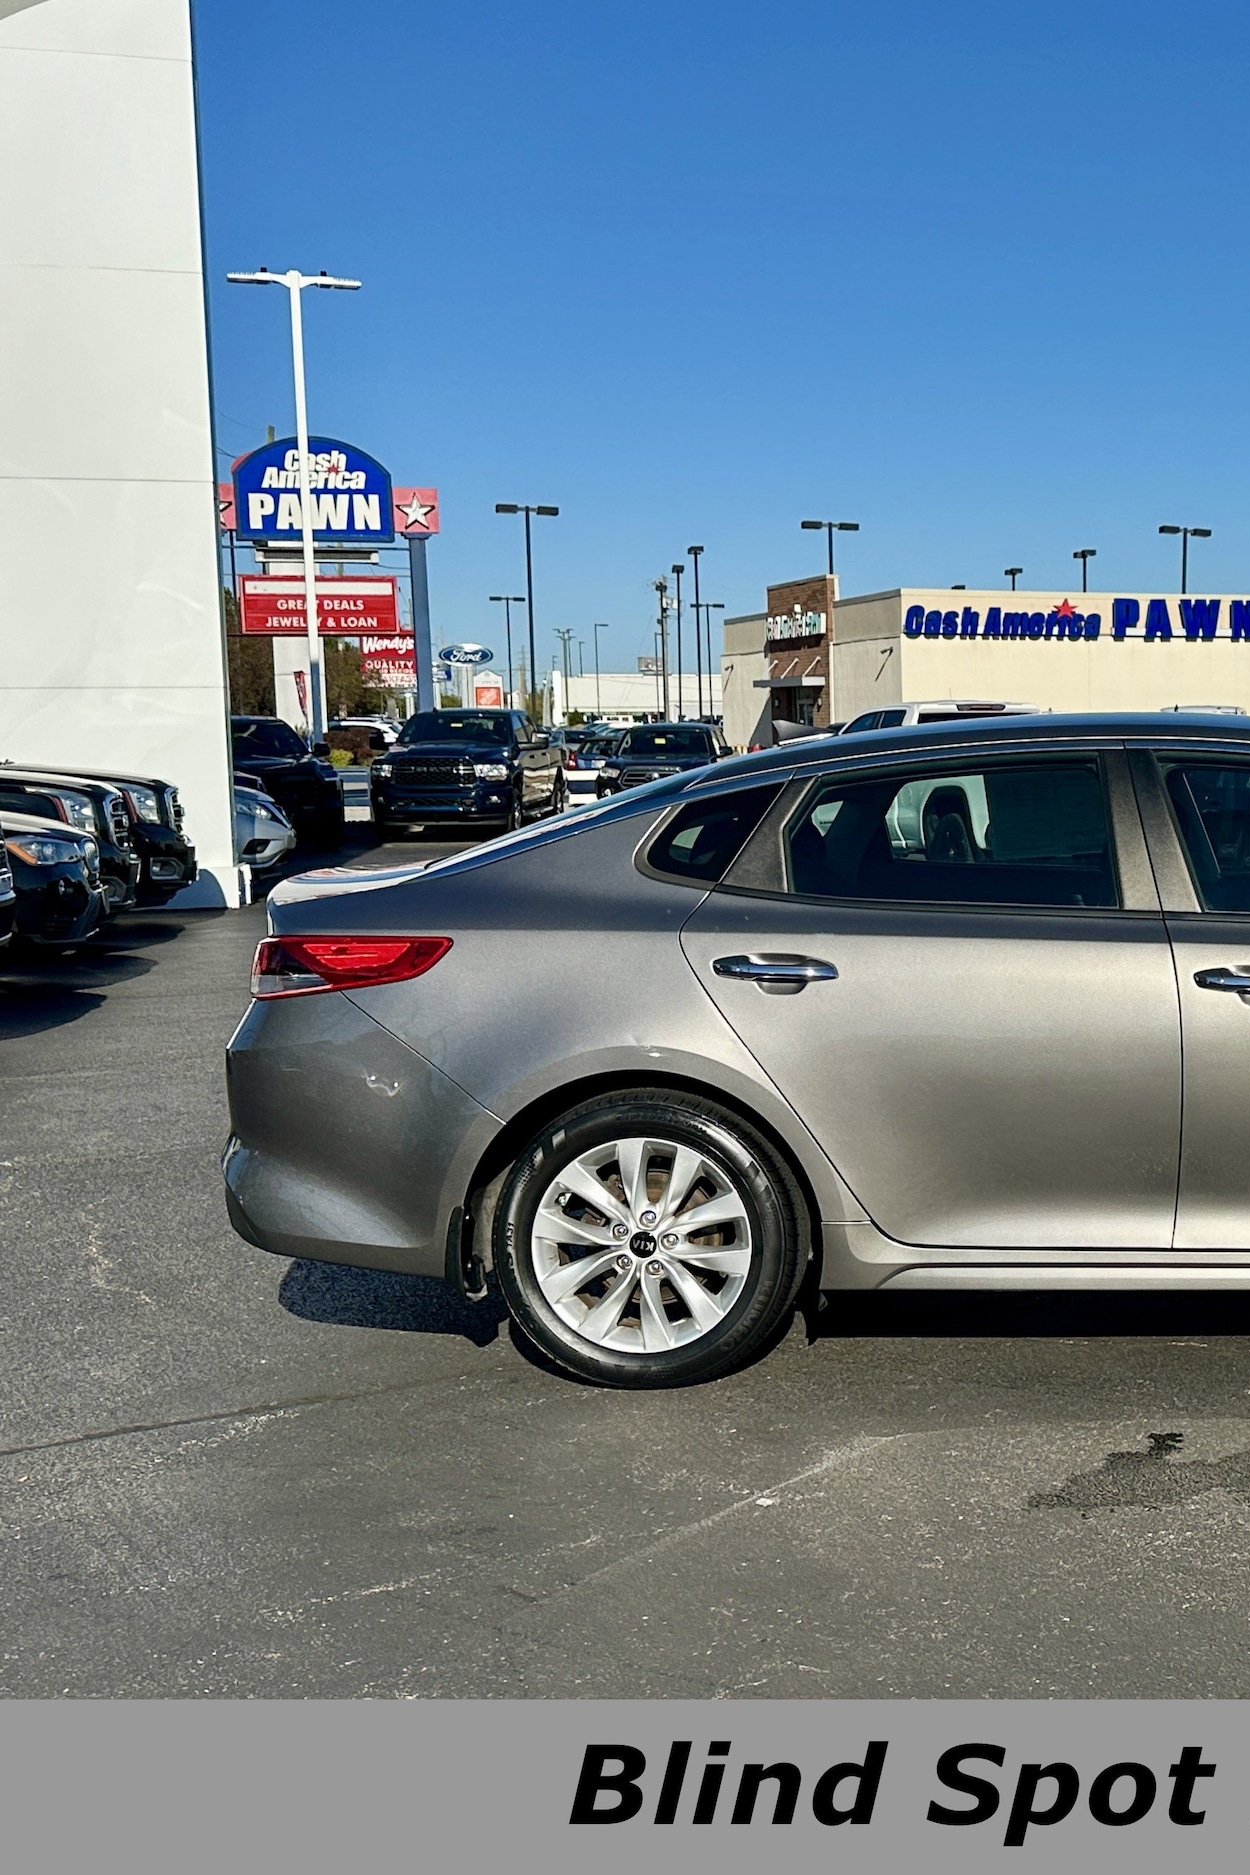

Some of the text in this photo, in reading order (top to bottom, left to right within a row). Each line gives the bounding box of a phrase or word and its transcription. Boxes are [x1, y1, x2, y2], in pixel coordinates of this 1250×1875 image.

[284, 449, 347, 471] Cash
[261, 467, 366, 489] America
[248, 493, 381, 530] PAWN
[277, 599, 364, 611] GRE DEALS
[266, 616, 378, 627] JEWELY & LOAN
[905, 605, 980, 639] Cash
[982, 607, 1101, 640] America
[362, 636, 415, 655] Wendy's
[450, 649, 483, 662] Ford
[365, 660, 414, 669] QUALITY
[632, 1238, 655, 1252] KIA
